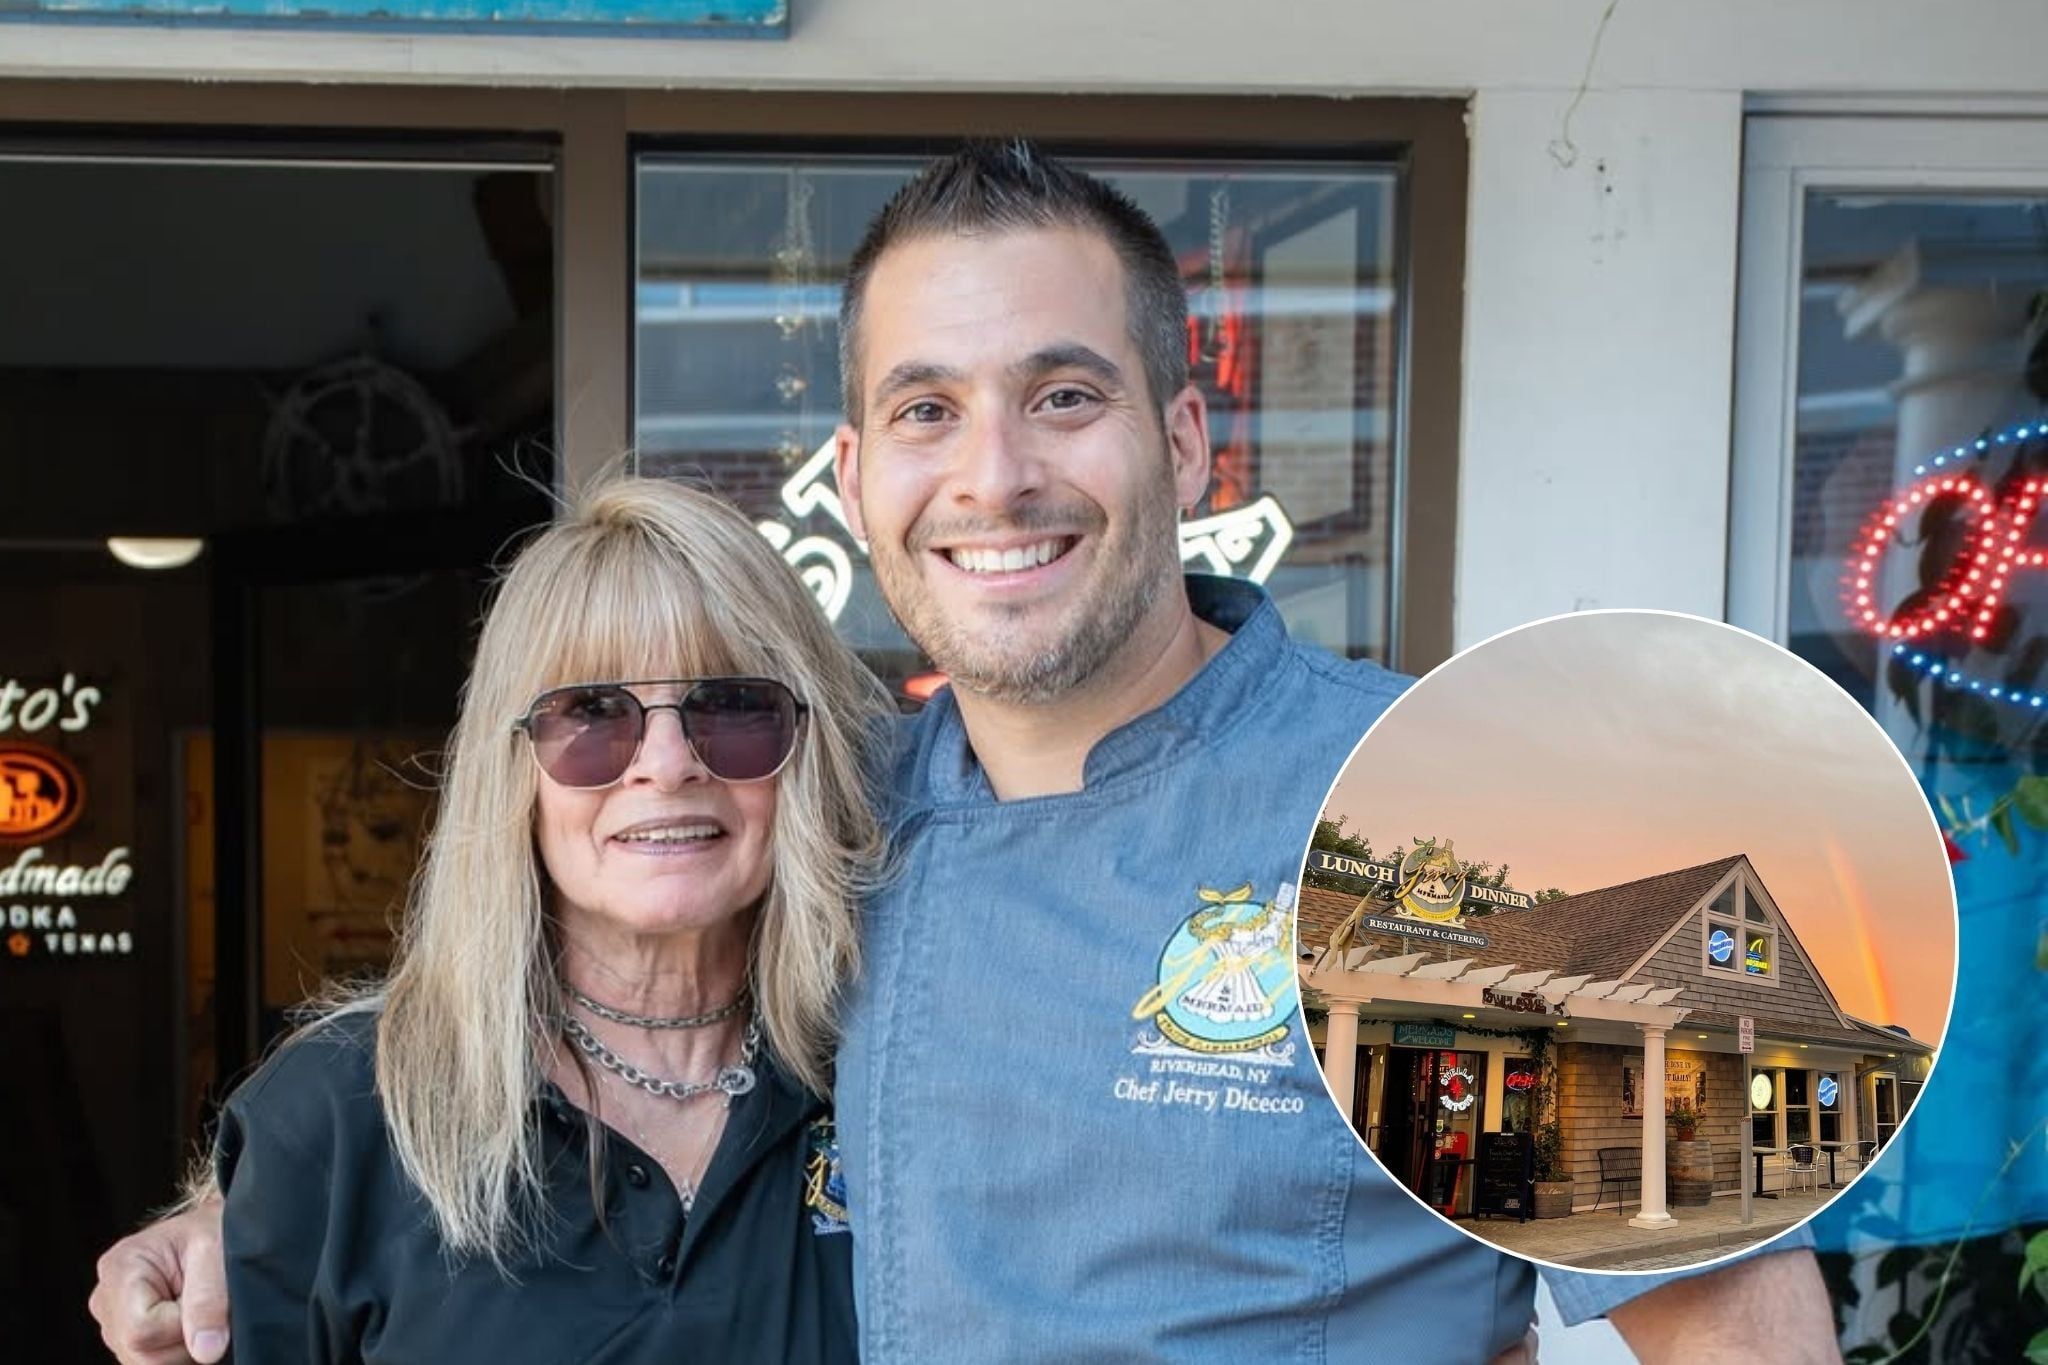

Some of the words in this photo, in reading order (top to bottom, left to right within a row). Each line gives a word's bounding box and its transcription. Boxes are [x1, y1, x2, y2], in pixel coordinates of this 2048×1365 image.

[1319, 853, 1395, 883] LUNCH
[1470, 884, 1530, 909] DINNER
[0, 905, 77, 929] DKA
[44, 932, 133, 953] TEXAS
[1368, 919, 1432, 938] RESTAURANT
[1432, 929, 1440, 938] &
[1441, 930, 1485, 946] CATERING
[1411, 1034, 1452, 1045] WELCOME
[1246, 1068, 1271, 1084] NY
[1440, 1067, 1474, 1086] STELLA
[1113, 1078, 1158, 1103] Chef
[1163, 1079, 1219, 1110] Jerry
